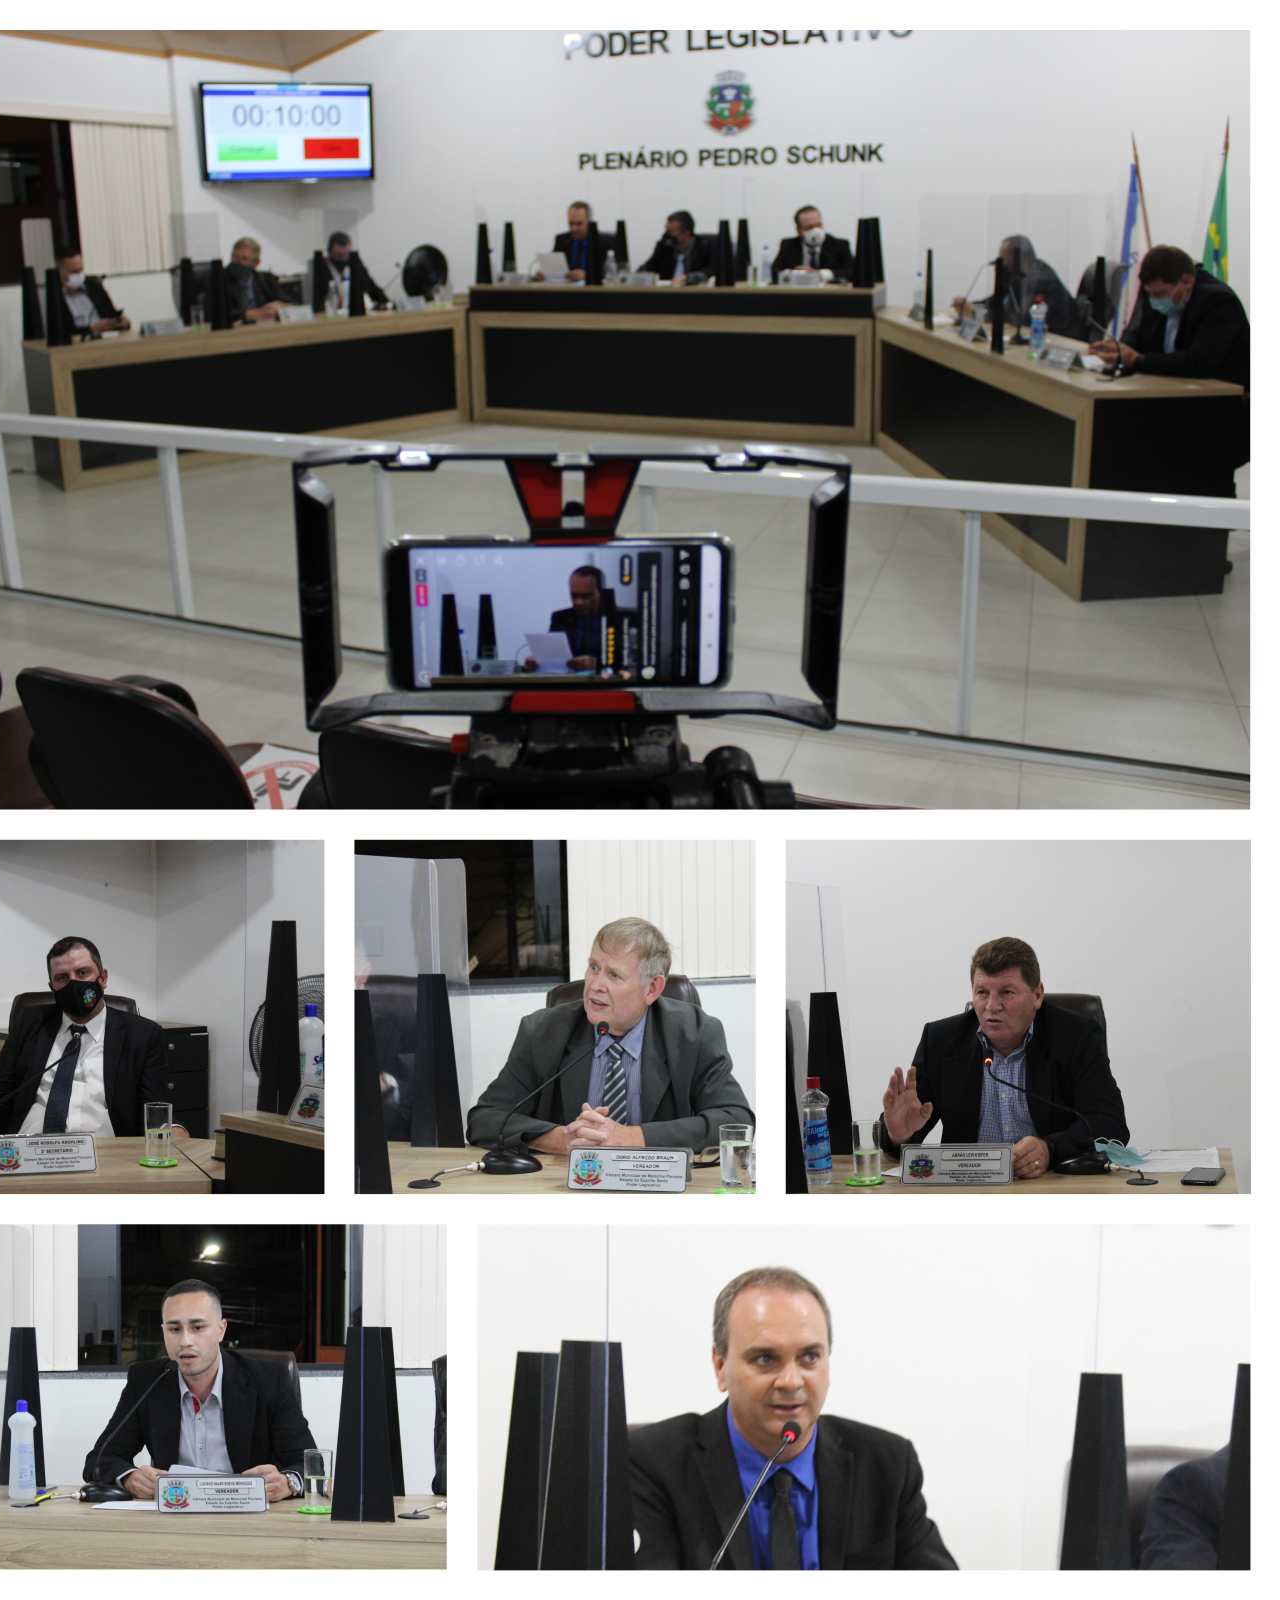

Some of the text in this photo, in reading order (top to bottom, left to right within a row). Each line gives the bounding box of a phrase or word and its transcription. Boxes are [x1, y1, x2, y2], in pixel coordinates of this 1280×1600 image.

[563, 30, 669, 60] PODER
[232, 104, 341, 126] 00:10:00
[579, 144, 884, 170] PLENÁRIO PEDRO SCHUNK
